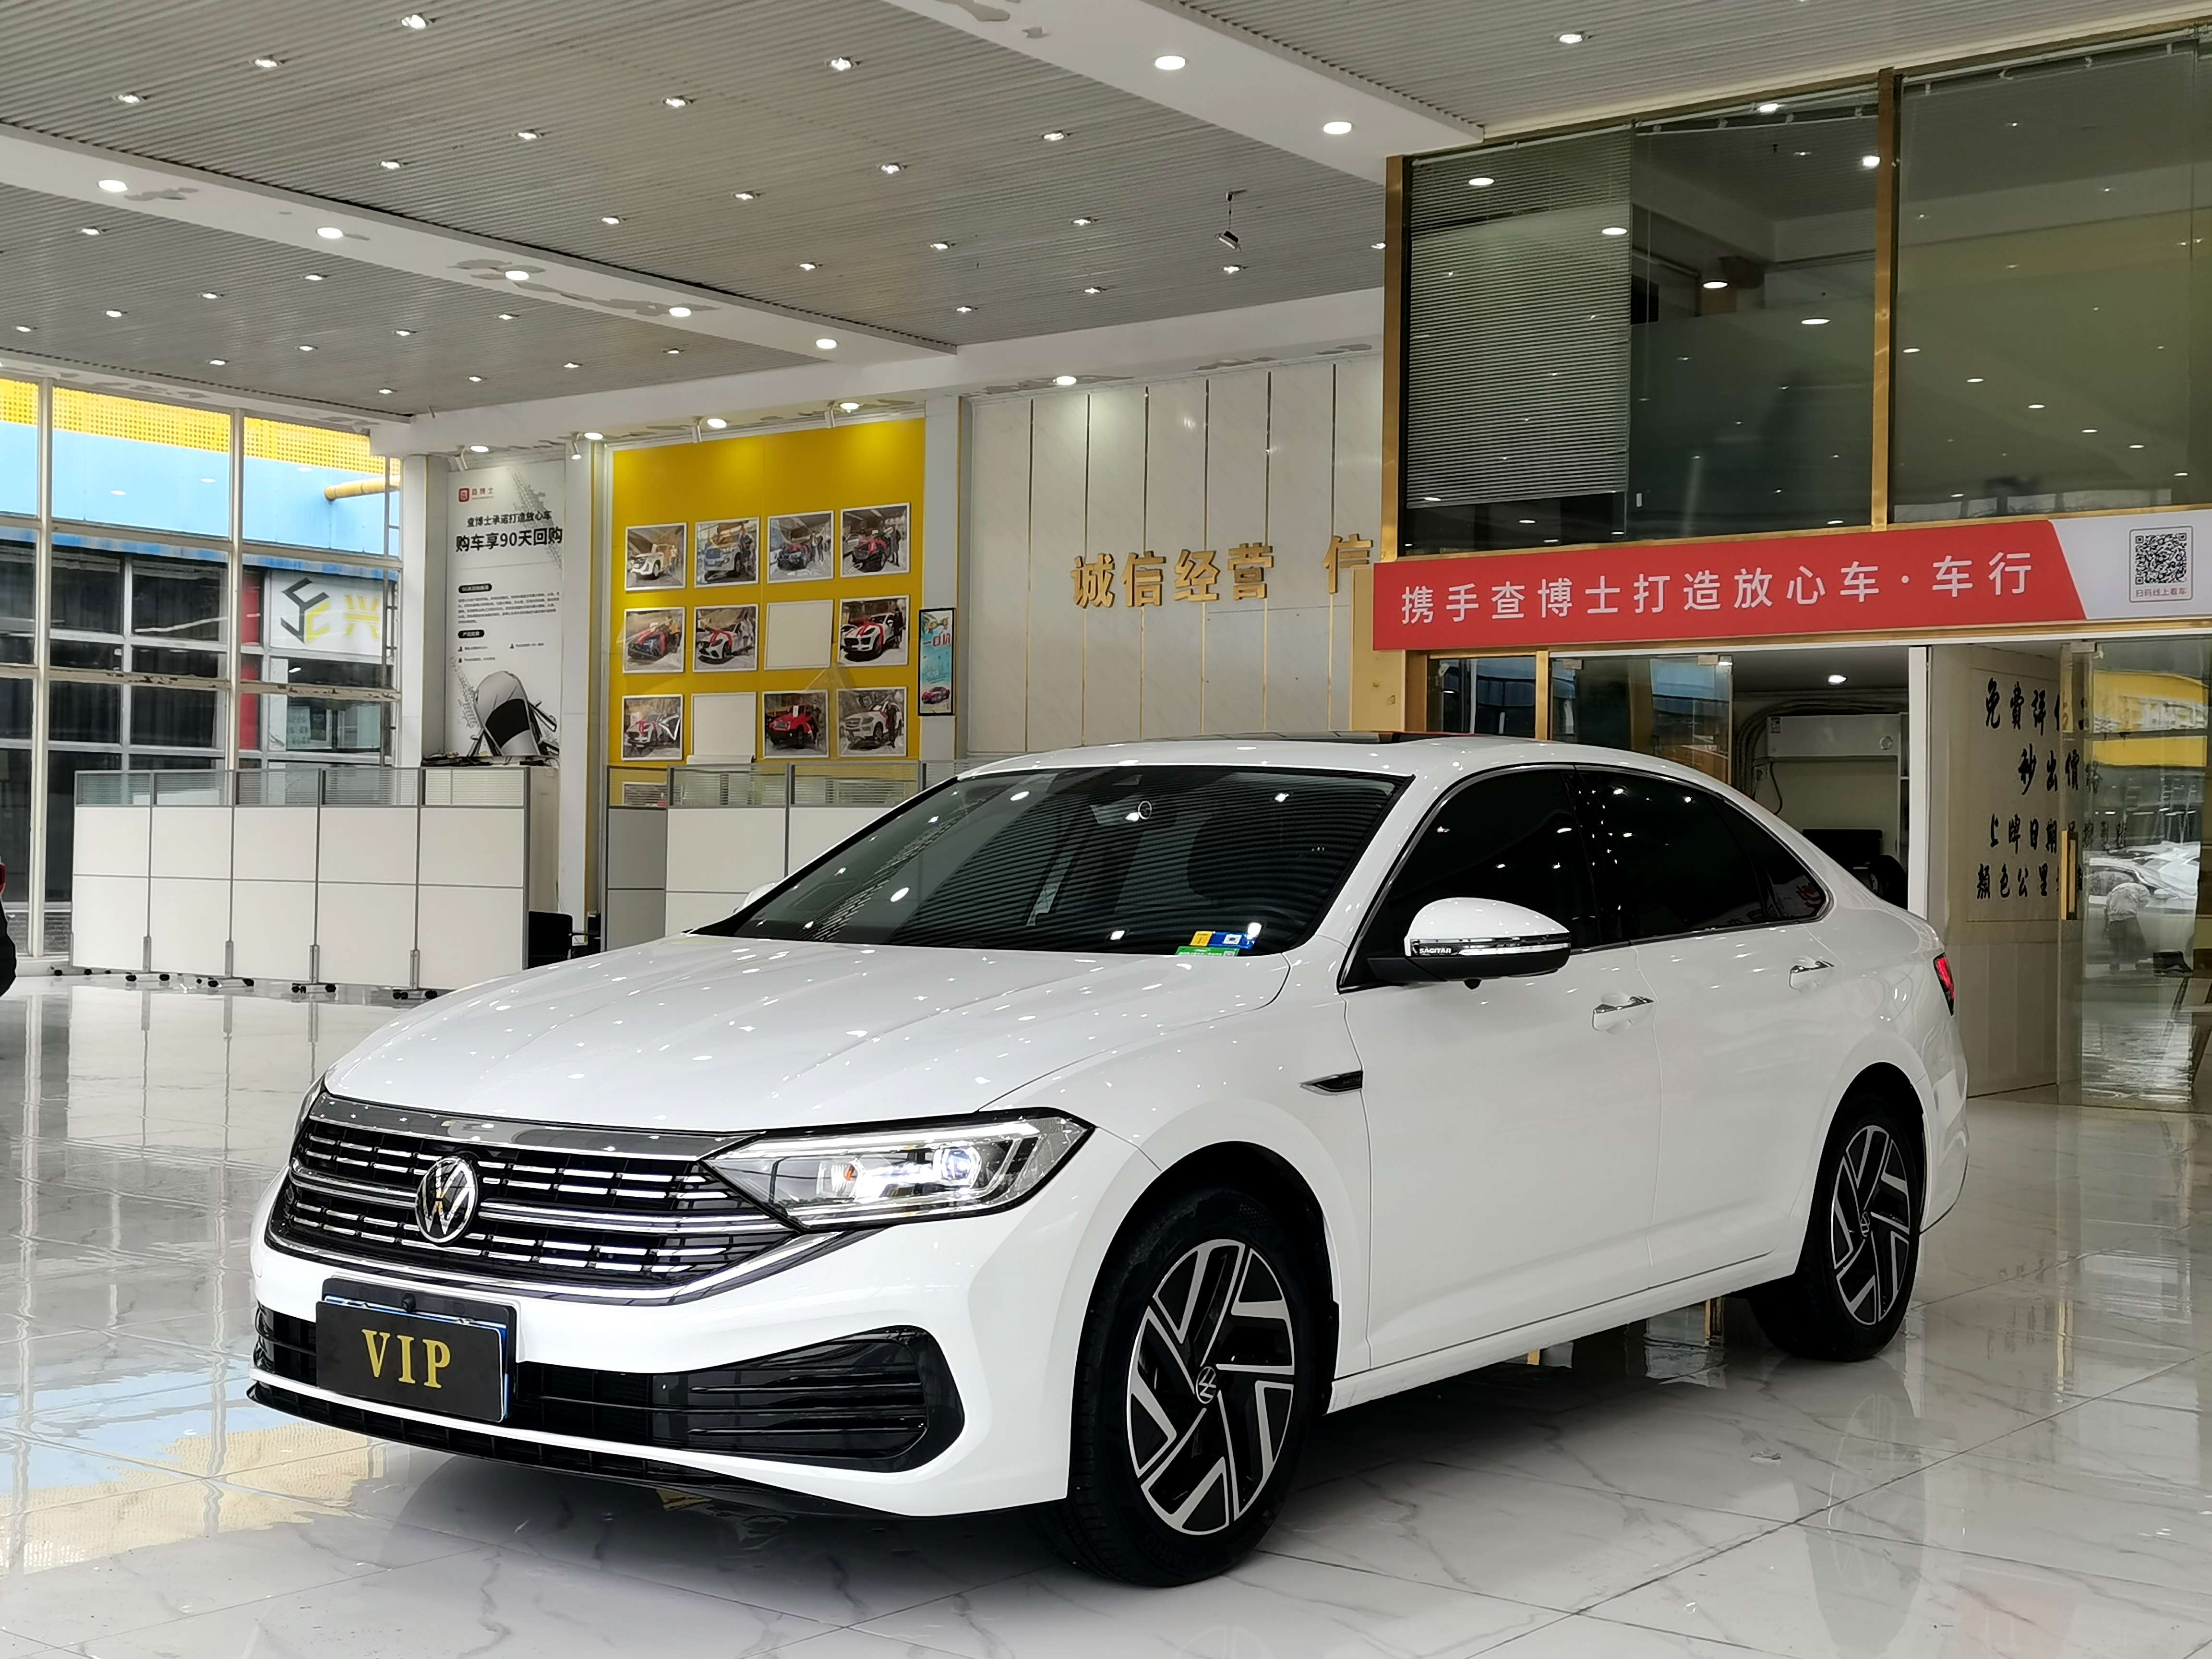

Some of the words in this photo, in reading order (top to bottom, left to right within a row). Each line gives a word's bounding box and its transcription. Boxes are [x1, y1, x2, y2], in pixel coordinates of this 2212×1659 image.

[456, 526, 563, 552] 购车享90天回购
[1070, 541, 1274, 609] 诚信经营
[1401, 552, 2032, 625] 携手查博士打造放心车·车行
[2135, 588, 2187, 597] 扫码线上看车
[361, 1328, 451, 1388] VIP
